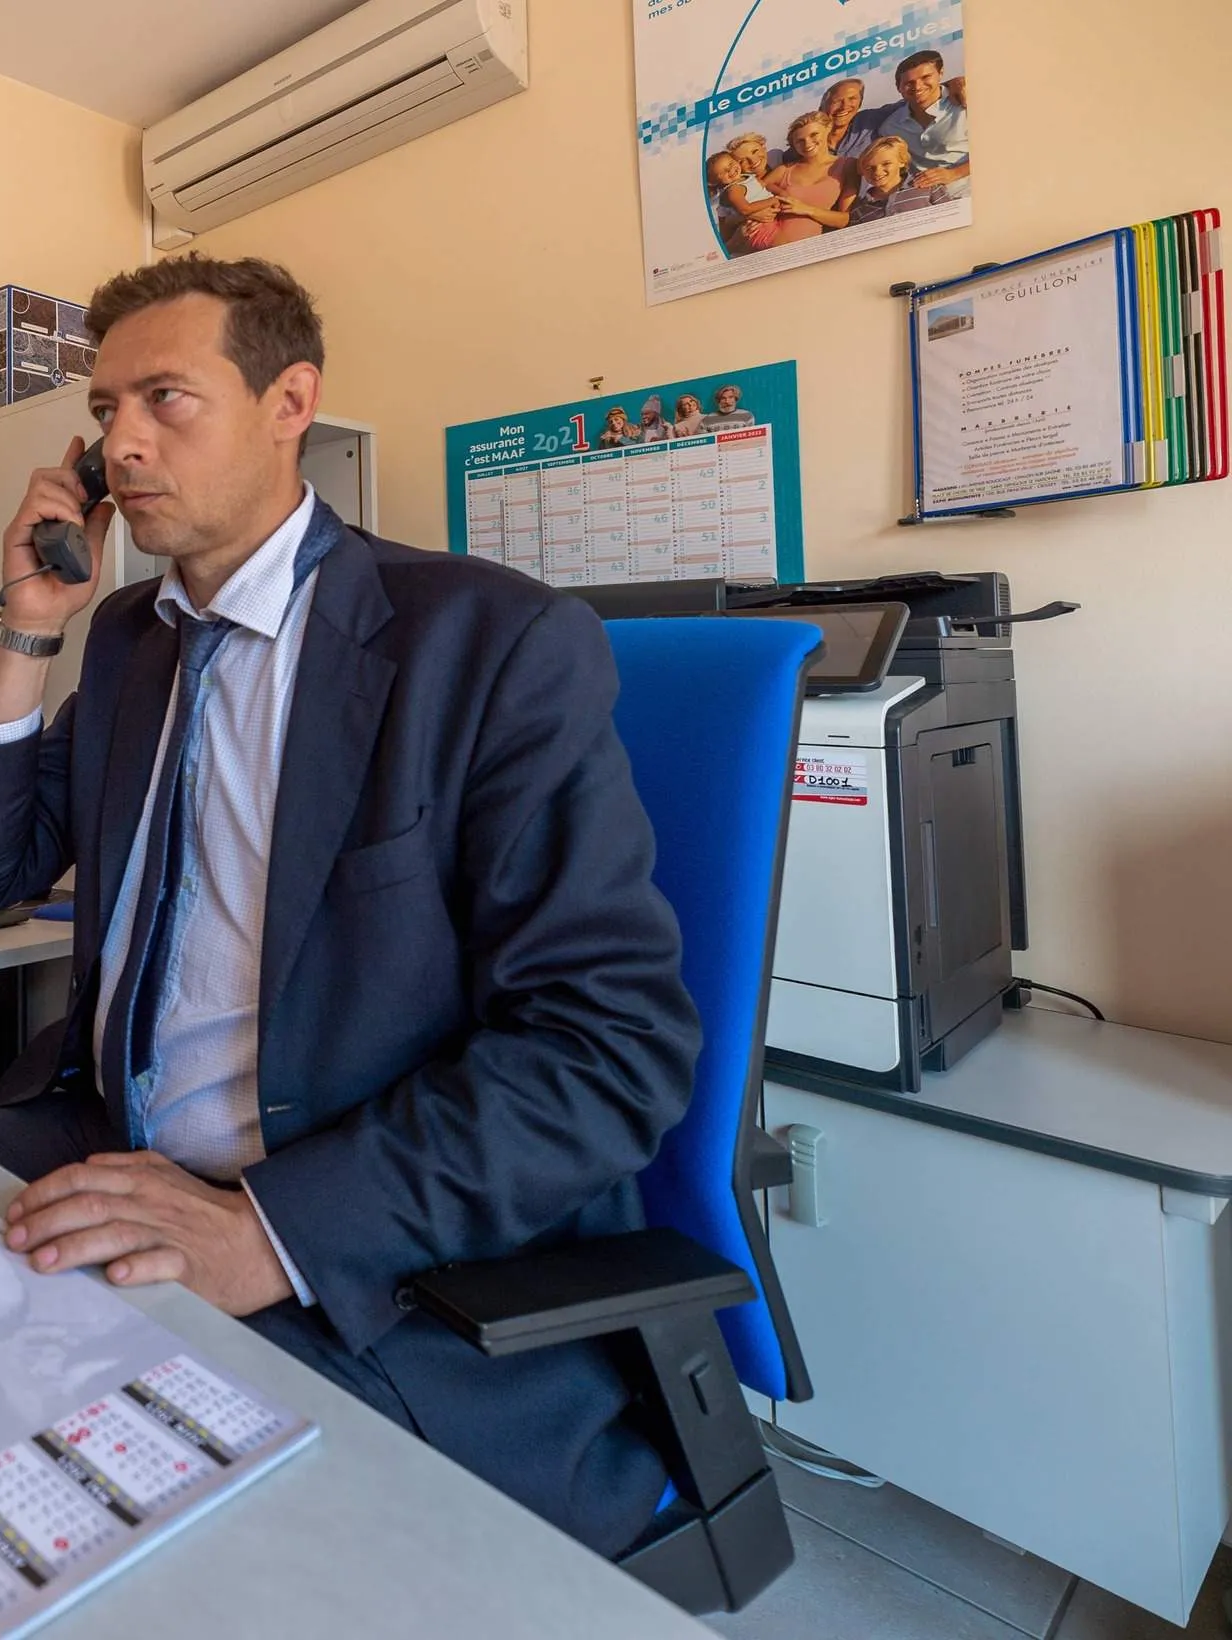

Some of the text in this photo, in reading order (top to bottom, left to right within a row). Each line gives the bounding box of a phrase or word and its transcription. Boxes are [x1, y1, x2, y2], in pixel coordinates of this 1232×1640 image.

[648, 5, 673, 19] mes
[709, 100, 730, 115] Le
[737, 62, 818, 102] Contrat
[1005, 274, 1077, 301] GUILLON
[500, 425, 524, 436] Mon
[533, 414, 589, 452] 2021
[721, 433, 746, 441] JANVIER
[470, 437, 524, 453] assurance
[631, 446, 660, 454] NOVEMBRE
[465, 448, 525, 466] c'est MAAF
[758, 480, 766, 489] 2
[701, 501, 715, 510] 50
